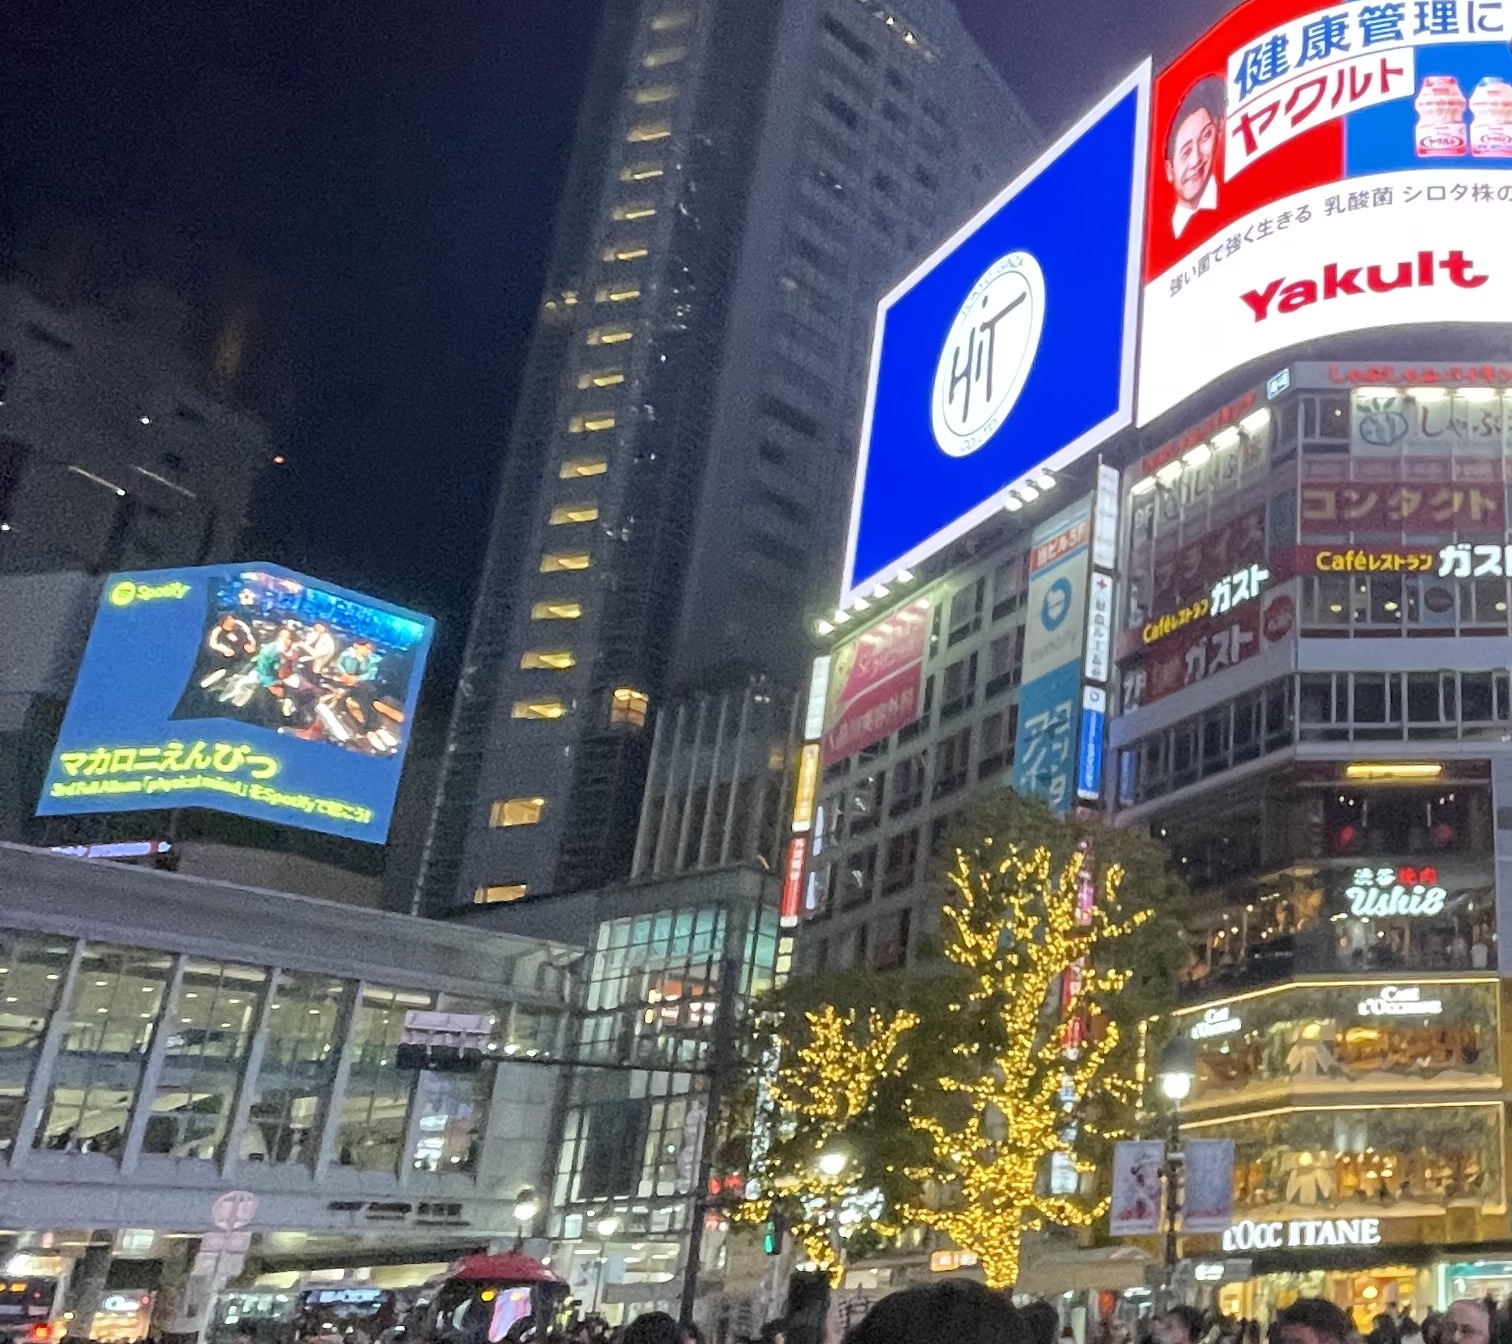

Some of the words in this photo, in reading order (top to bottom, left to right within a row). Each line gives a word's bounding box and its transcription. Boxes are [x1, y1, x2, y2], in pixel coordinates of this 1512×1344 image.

[1233, 0, 1505, 102] 健康管理に
[1231, 57, 1404, 157] ヤクルト
[1168, 205, 1312, 298] 強い菌で強く生きる
[1324, 187, 1394, 218] 乳酸菌
[1240, 250, 1490, 324] Yakult
[1303, 487, 1497, 522] コンタクト
[1209, 562, 1271, 617] ガスト
